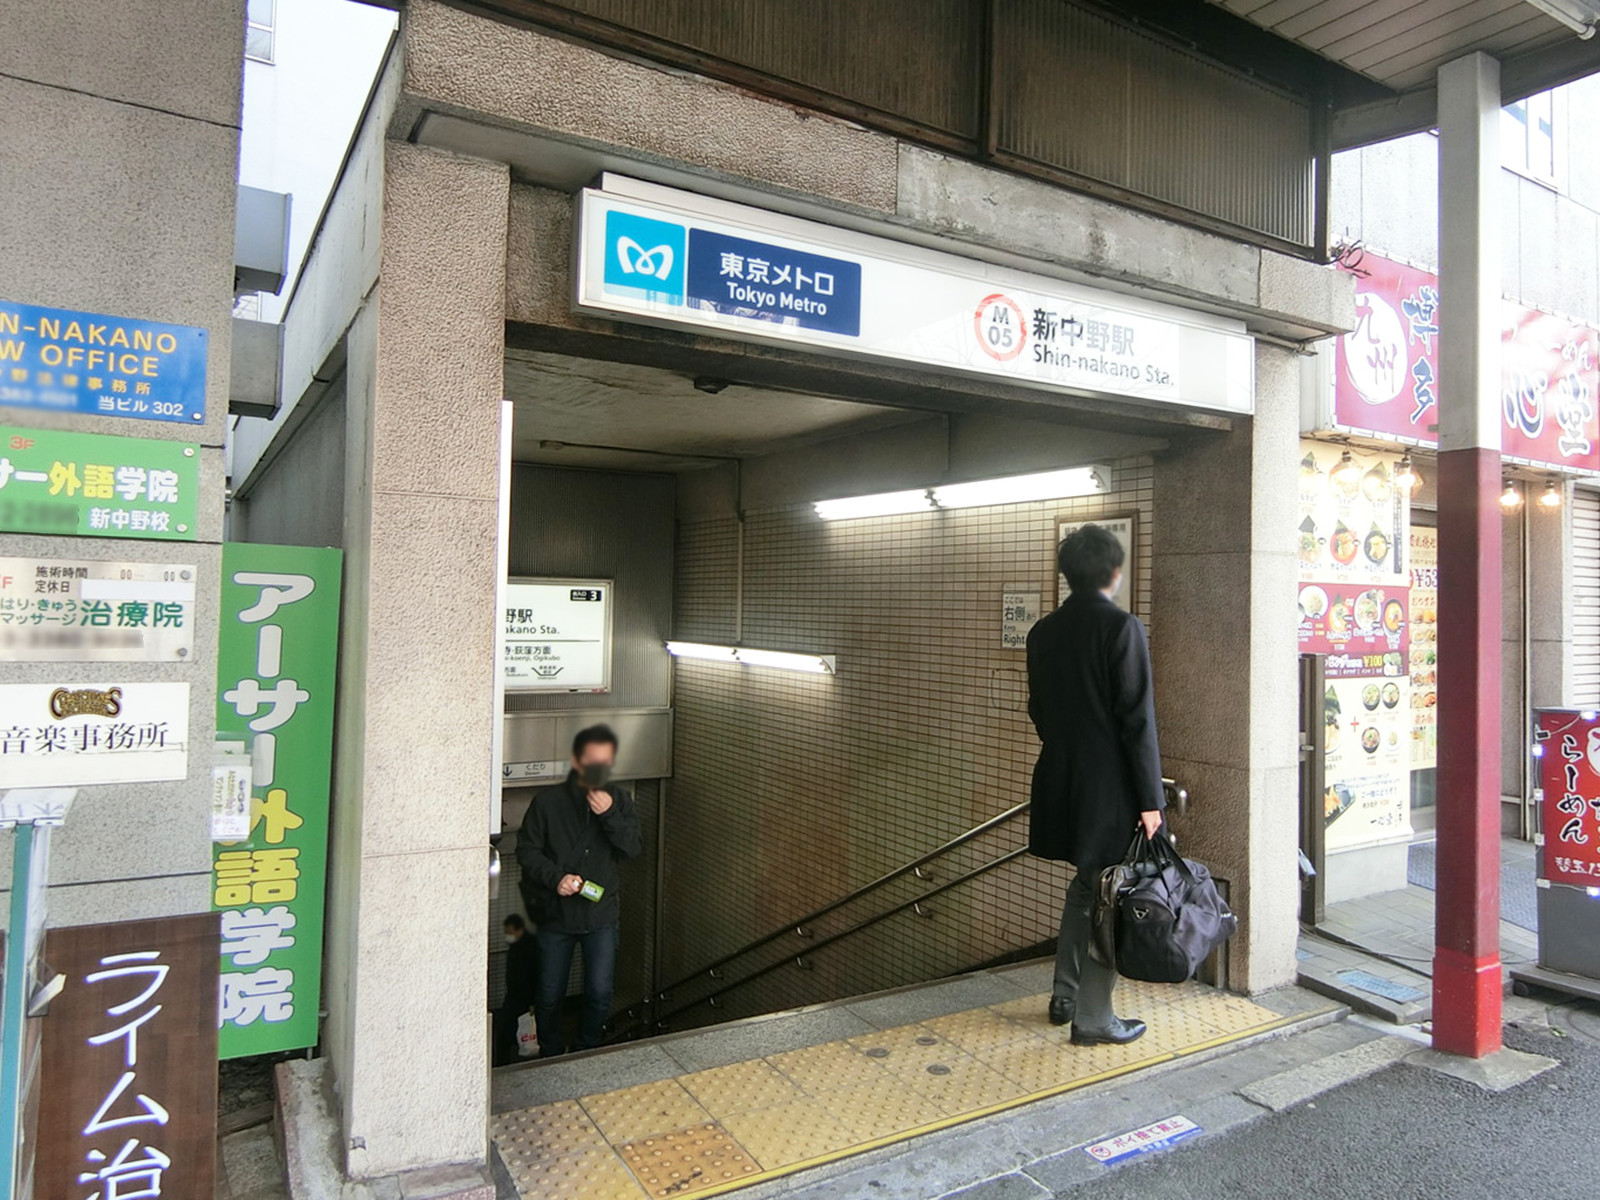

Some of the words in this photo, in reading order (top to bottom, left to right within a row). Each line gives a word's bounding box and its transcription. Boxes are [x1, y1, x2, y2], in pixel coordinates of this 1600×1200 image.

[719, 252, 834, 296] 東京メトロ
[726, 282, 776, 308] Tokyo
[780, 292, 827, 316] Metro
[992, 306, 1010, 325] M
[0, 311, 178, 354] N-NAKANO
[988, 326, 1013, 348] 05
[1033, 307, 1135, 357] 新中野駅
[40, 344, 159, 378] OFFICE
[1033, 343, 1140, 380] Shin-nakano
[1145, 364, 1175, 387] Sta.
[98, 394, 149, 415] 当ビル
[152, 401, 183, 418] 302
[8, 434, 35, 451] 3F
[90, 507, 170, 533] 新中野校
[35, 566, 88, 579] 施術時間
[35, 580, 70, 593] 定休日
[590, 590, 598, 601] 3
[2, 612, 77, 626] マッサージ
[80, 600, 184, 628] 治療院
[540, 625, 560, 634] Sta.
[1004, 634, 1025, 646] Right
[0, 722, 168, 755] 音楽事務所
[1557, 734, 1588, 844] らーめん
[1112, 1119, 1184, 1149] ポイ捨て禁止
